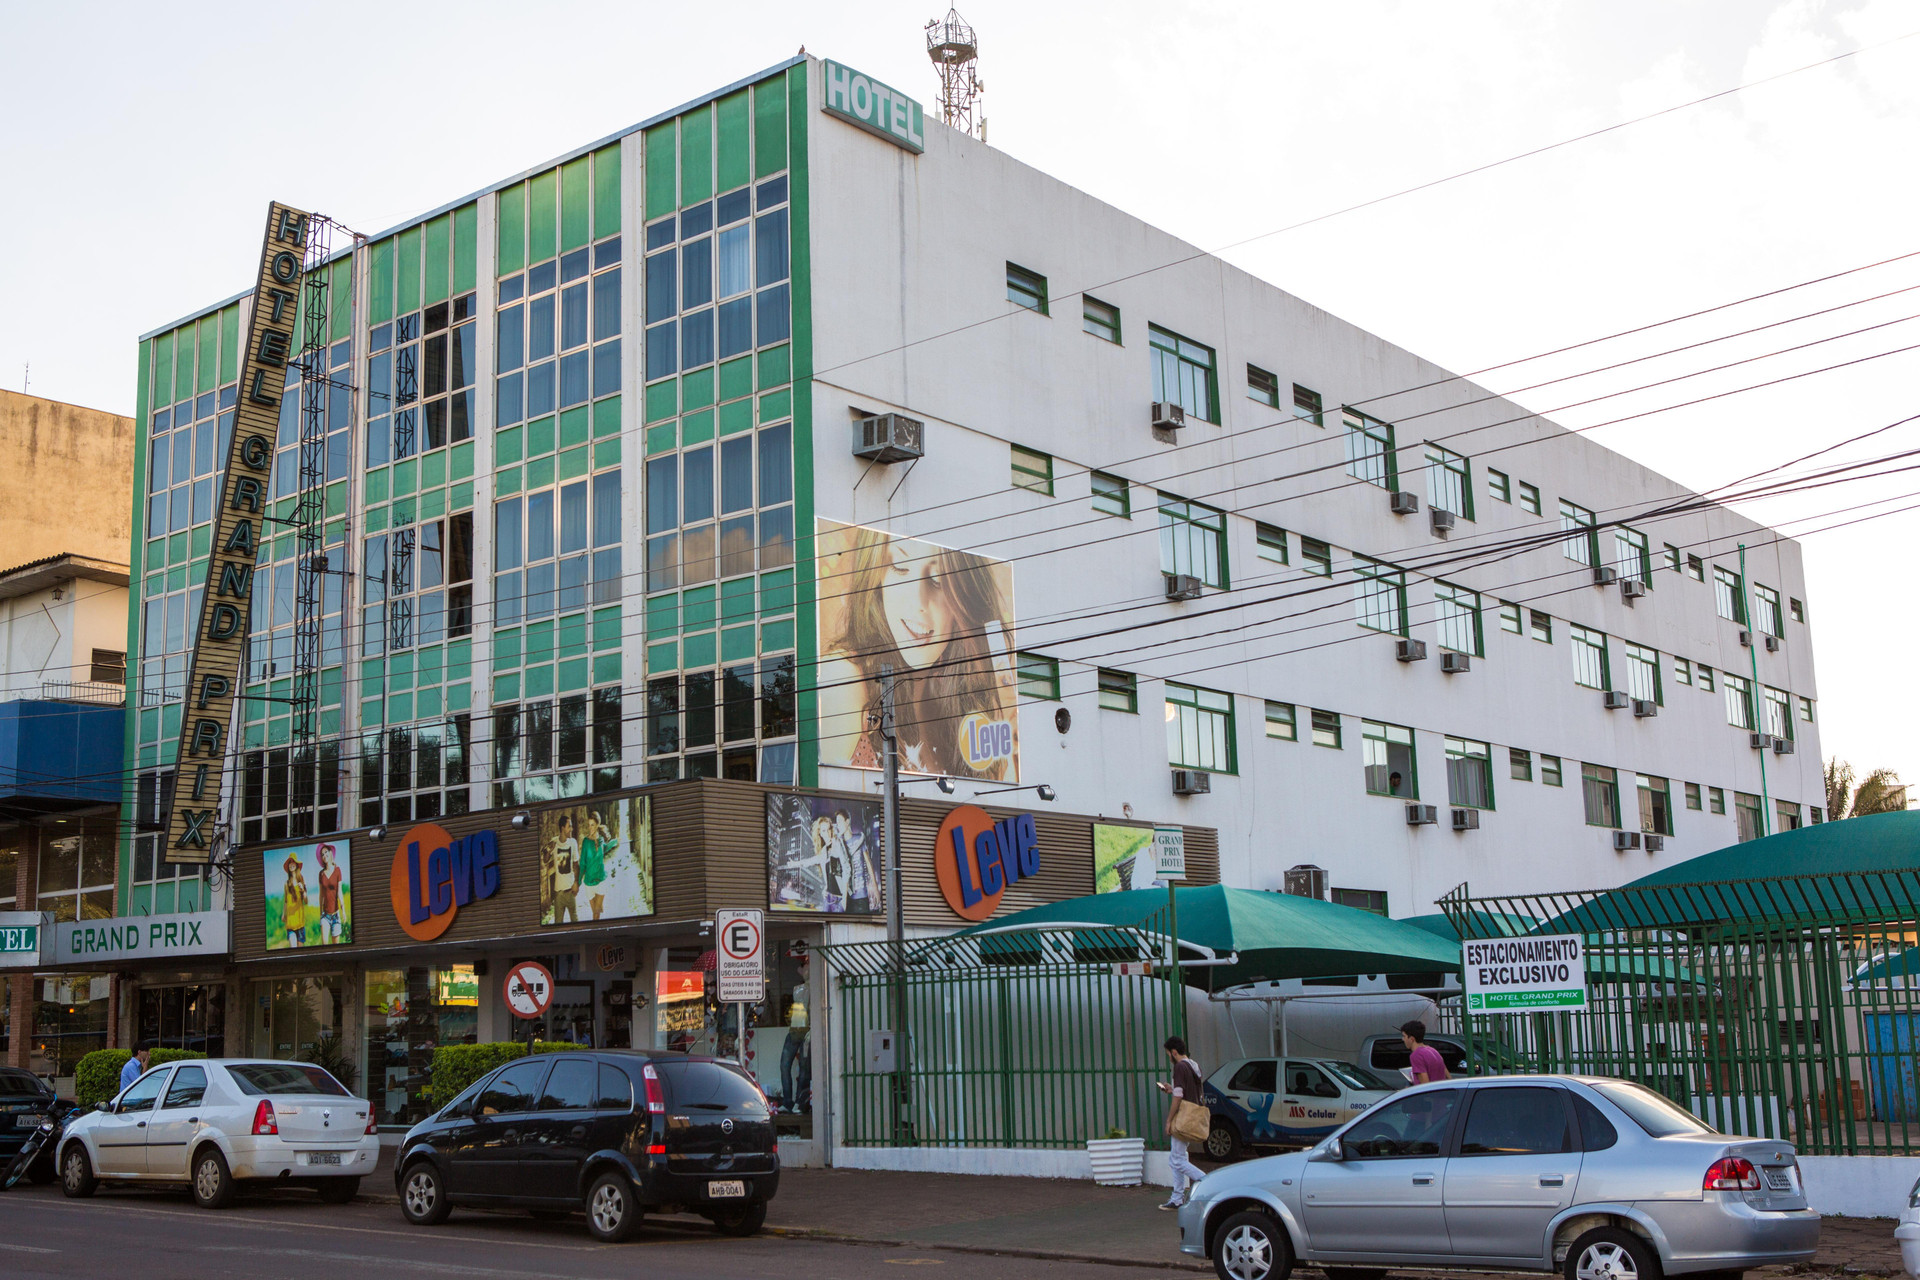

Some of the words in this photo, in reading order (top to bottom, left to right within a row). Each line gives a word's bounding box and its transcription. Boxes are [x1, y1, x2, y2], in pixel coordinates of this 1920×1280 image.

[828, 62, 922, 149] HOTEL
[249, 209, 307, 406] HOTEL
[207, 435, 270, 640] GRAND
[969, 720, 1012, 762] Leve
[174, 674, 231, 848] PRIX
[1158, 835, 1183, 845] GRAND
[1163, 846, 1181, 856] PRIX
[952, 813, 1041, 909] Leve
[1161, 858, 1183, 867] HOTEL
[407, 829, 500, 925] Leve
[71, 924, 139, 954] GRAND
[150, 920, 203, 948] PRIX
[731, 926, 750, 952] E
[602, 946, 625, 967] Leve
[723, 961, 759, 969] OBRIGATÓRIO
[1467, 939, 1578, 965] ESTACIONAMENTO
[741, 968, 762, 976] CARTÃO
[1479, 964, 1569, 985] EXCLUSIVO
[1289, 1106, 1305, 1118] MS
[1307, 1109, 1337, 1119] Celular
